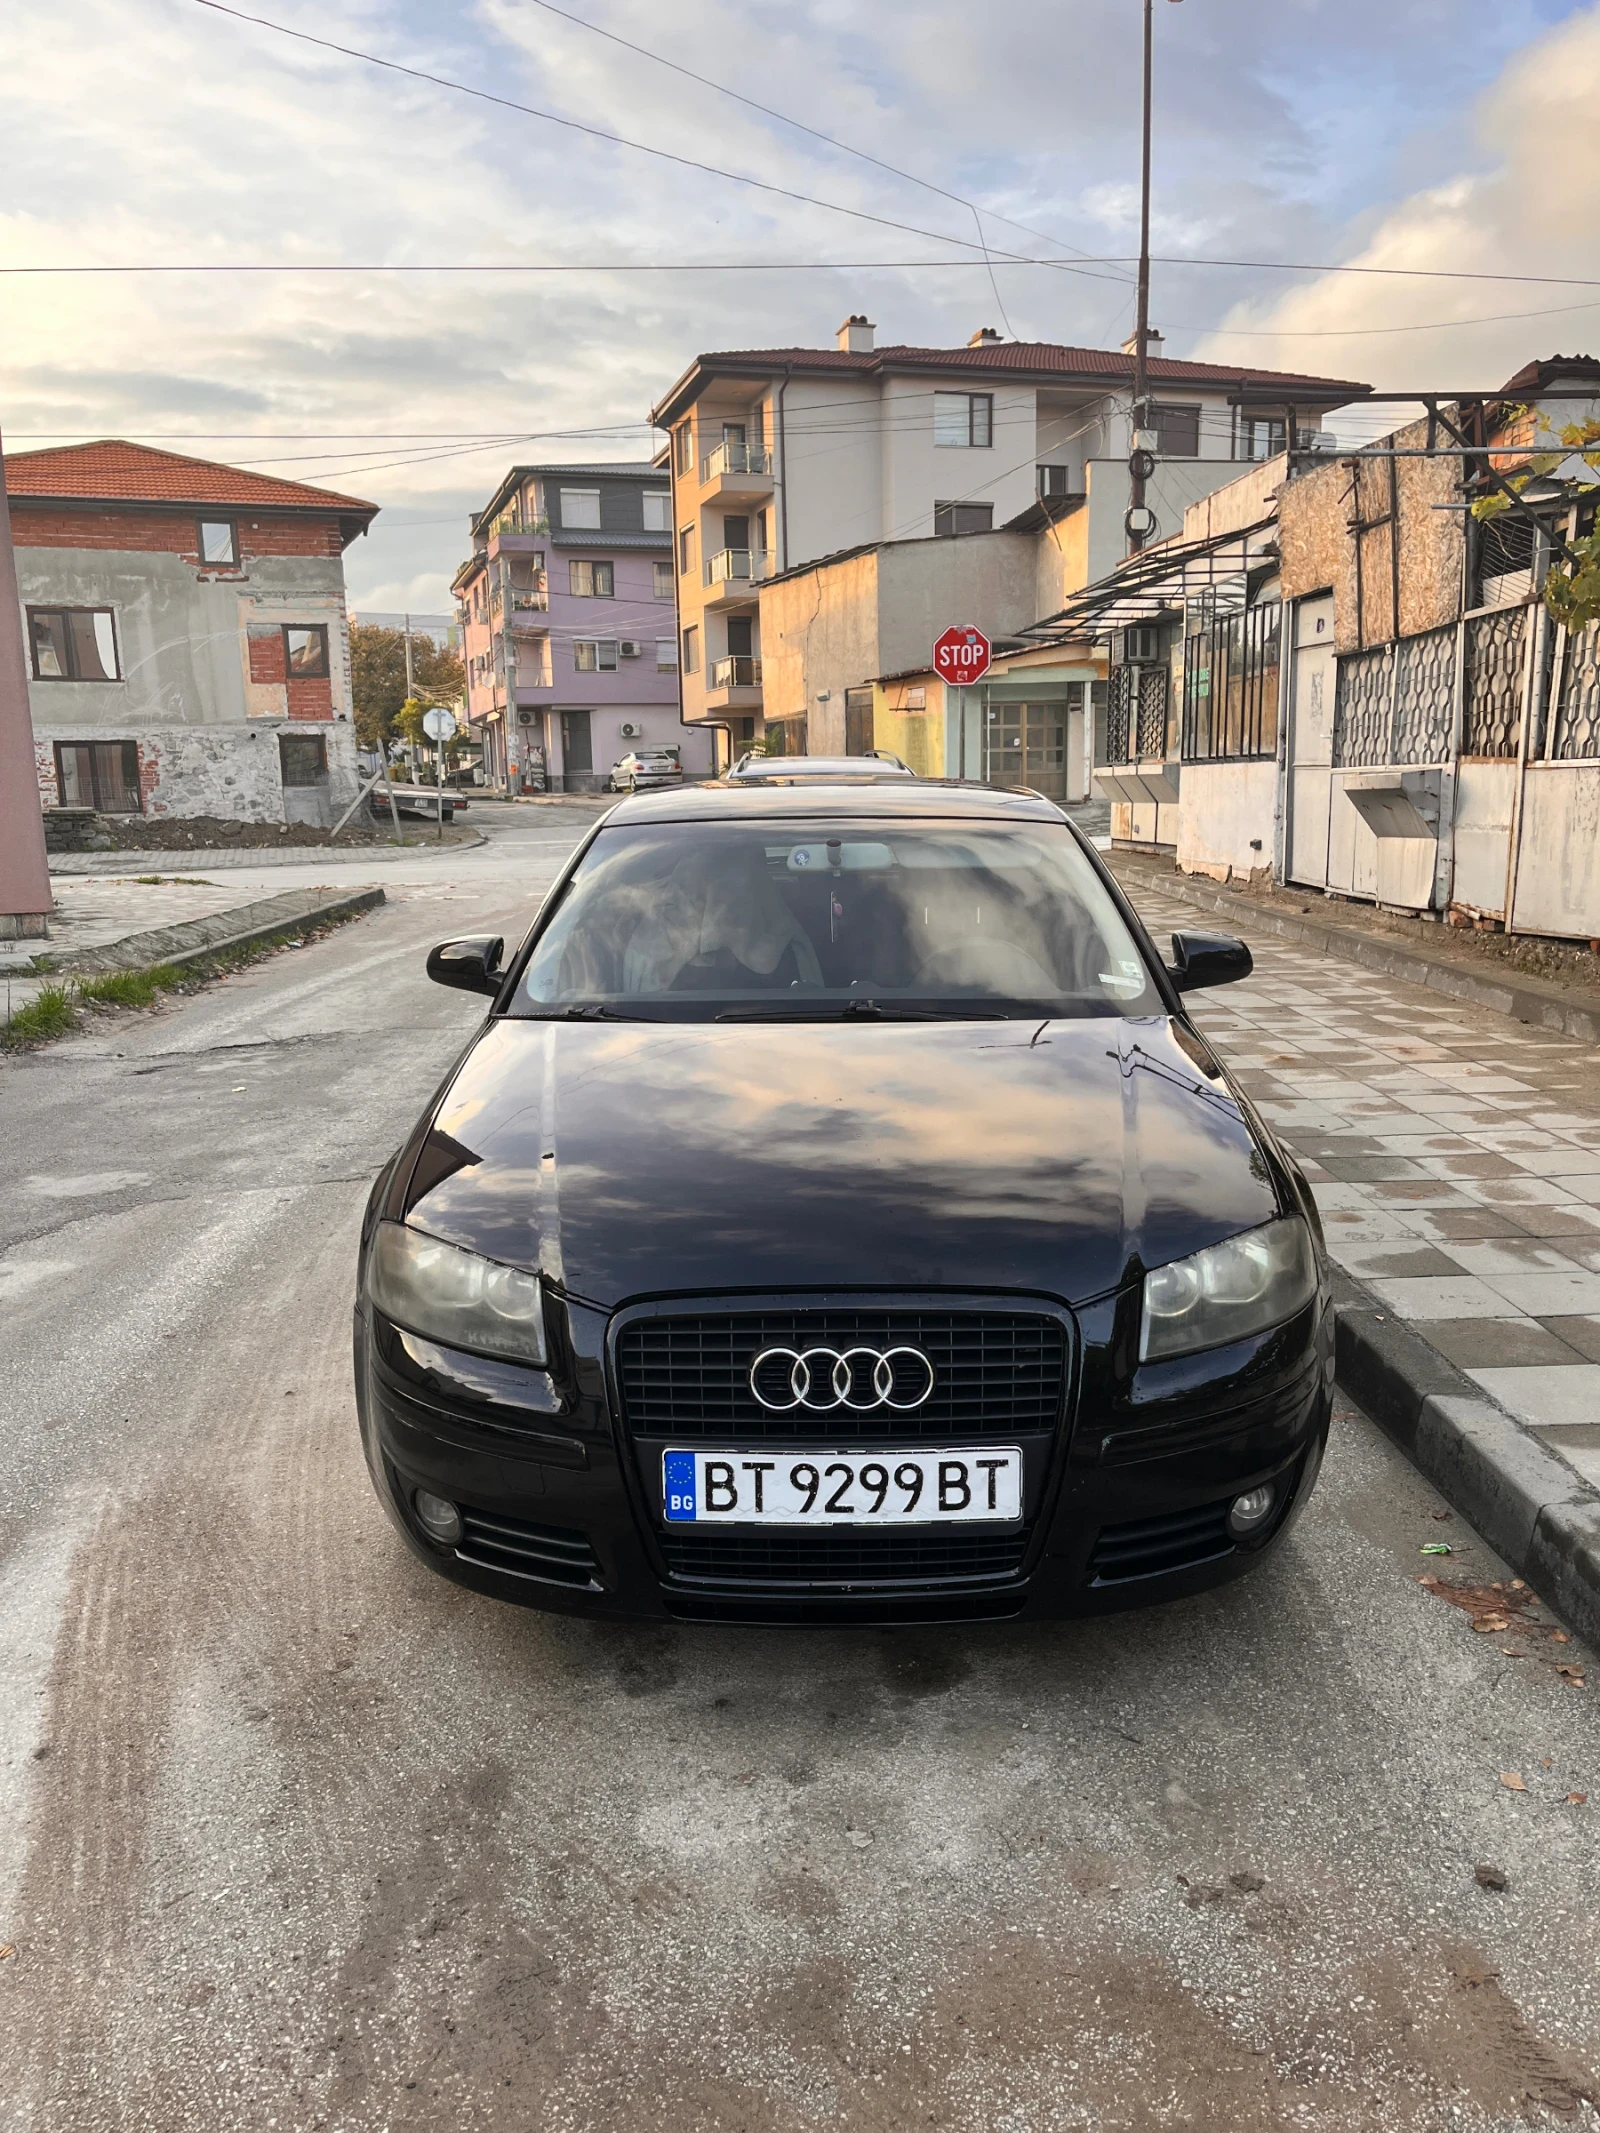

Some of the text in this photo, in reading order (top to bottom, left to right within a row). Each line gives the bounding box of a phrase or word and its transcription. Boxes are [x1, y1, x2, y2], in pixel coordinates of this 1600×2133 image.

[940, 645, 984, 666] STOP
[705, 1459, 1009, 1513] BT 9299 BT
[671, 1495, 693, 1511] BG
